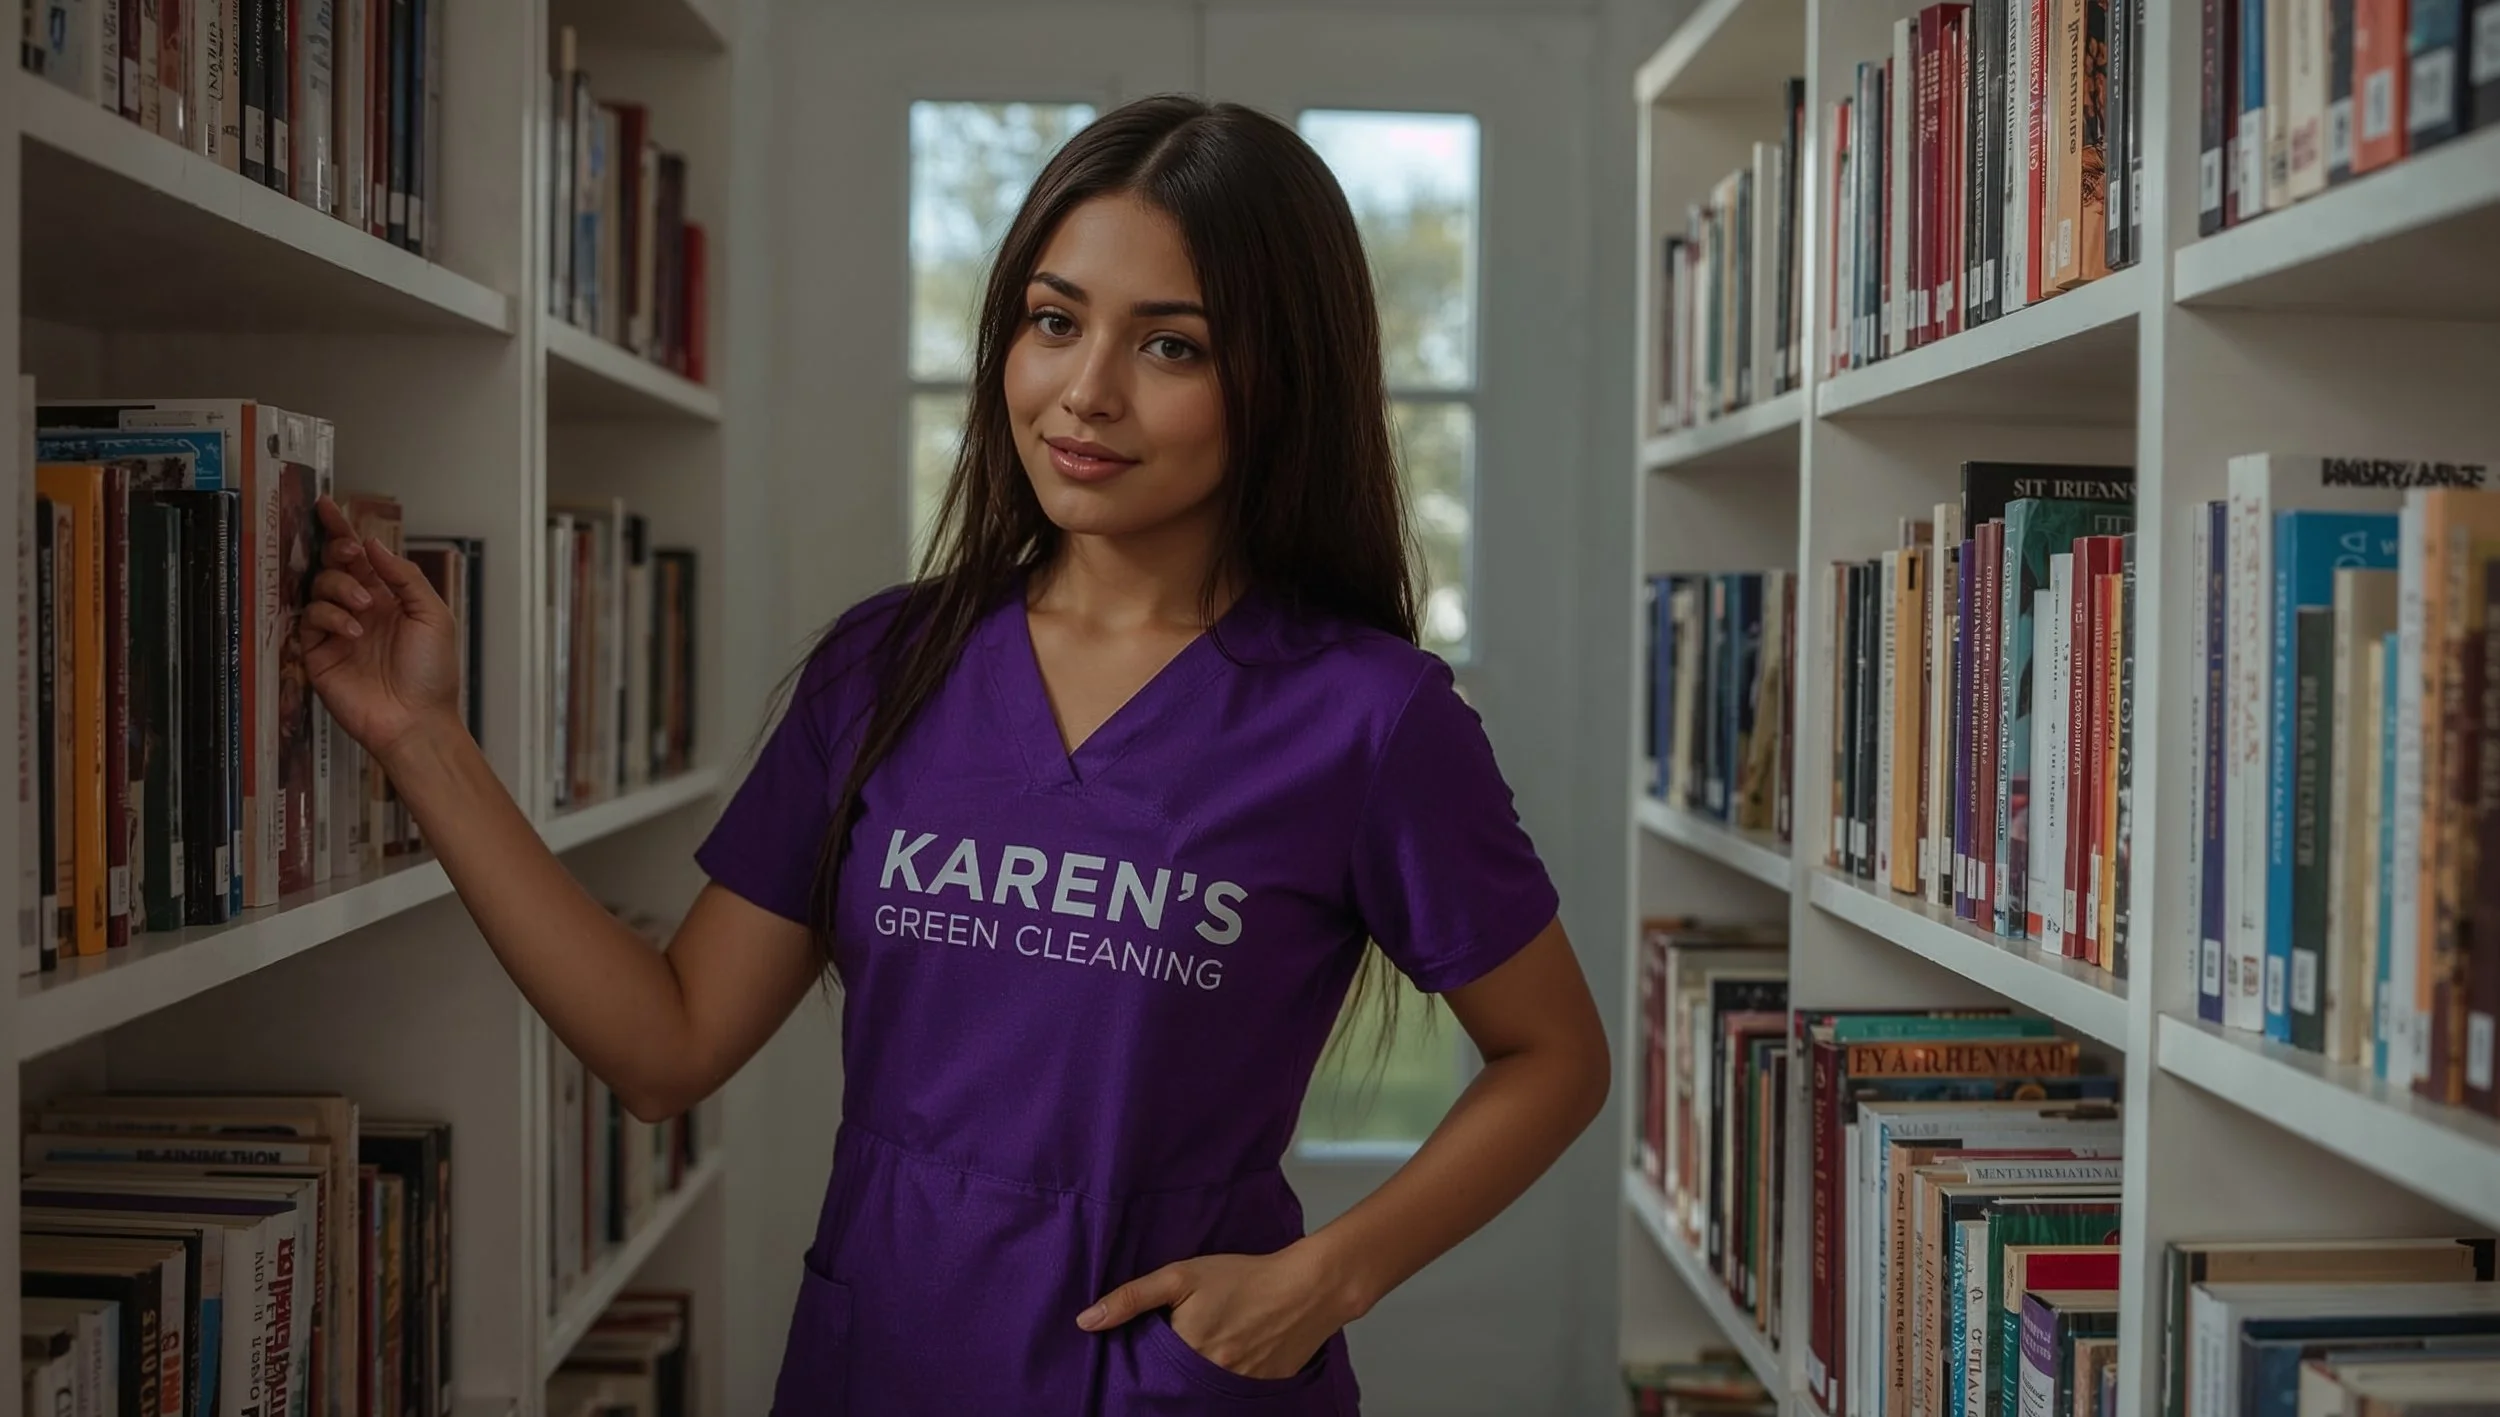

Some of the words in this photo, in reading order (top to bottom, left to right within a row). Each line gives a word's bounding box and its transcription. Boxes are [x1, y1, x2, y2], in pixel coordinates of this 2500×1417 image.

[879, 828, 1249, 946] KAREN'S
[874, 904, 1000, 951] GREEN
[1014, 924, 1224, 991] CLEANING
